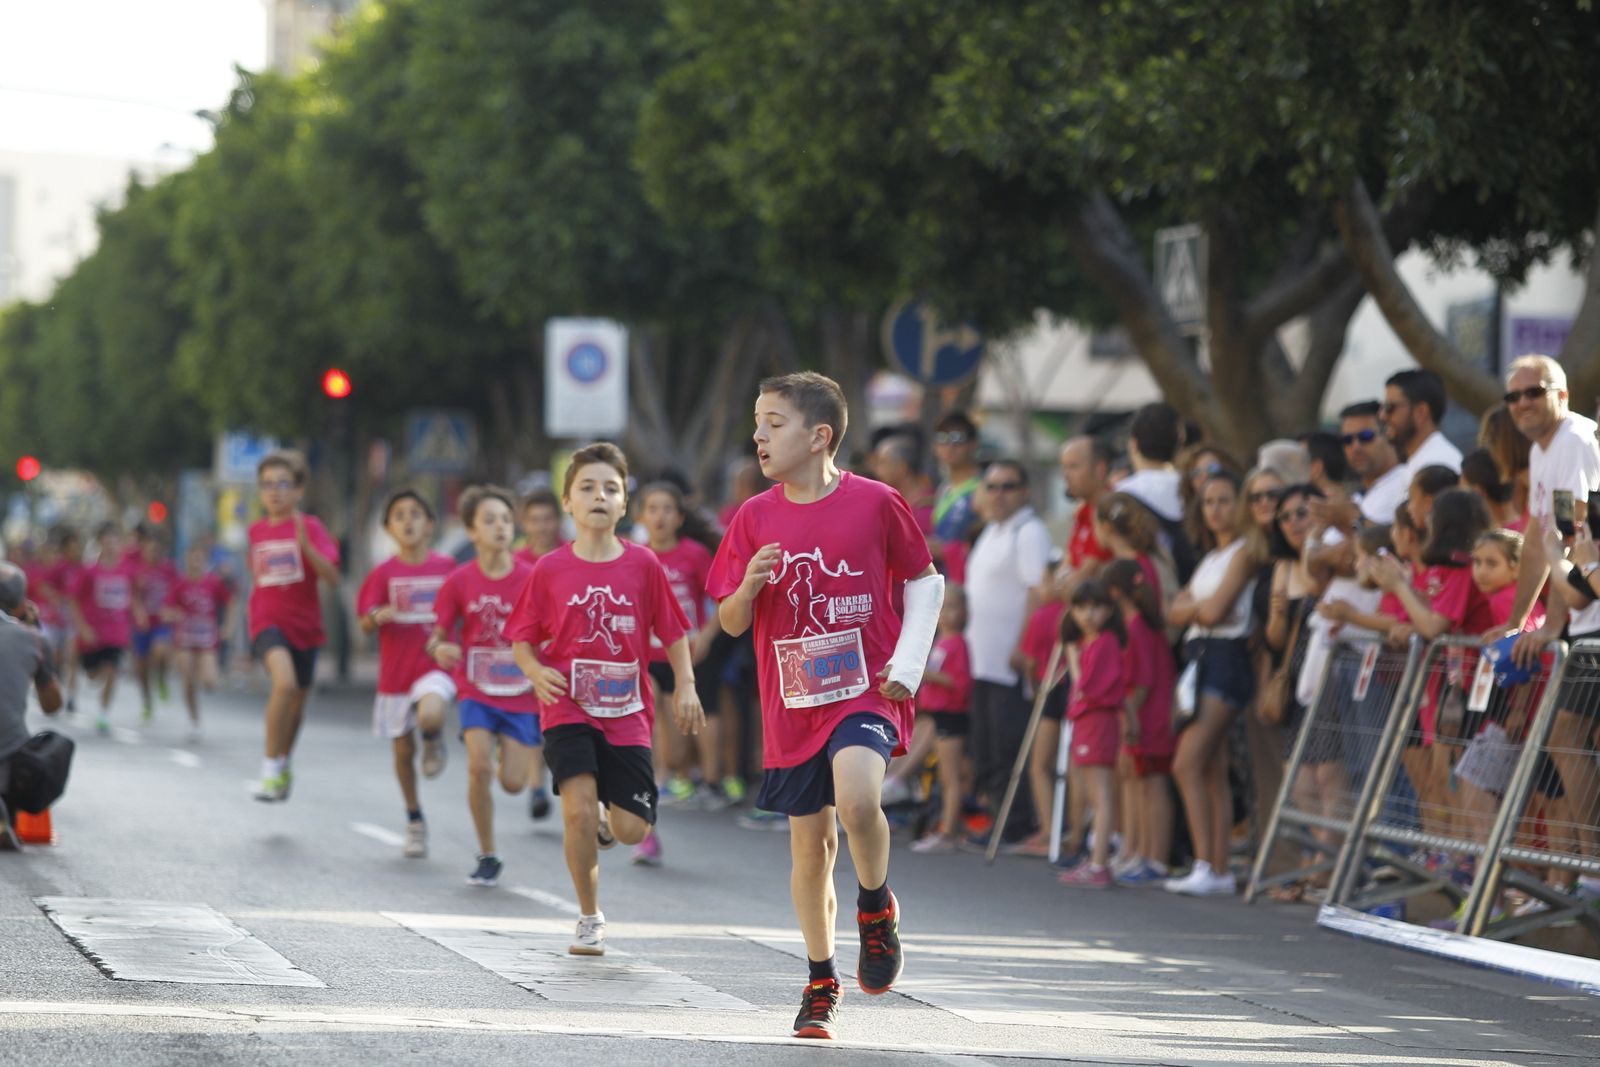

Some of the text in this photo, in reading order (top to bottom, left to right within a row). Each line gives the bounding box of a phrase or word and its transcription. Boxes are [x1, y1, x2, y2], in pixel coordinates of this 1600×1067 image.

[824, 593, 873, 624] 4 CARRERA
[836, 603, 872, 615] SOLIDARIA
[802, 650, 859, 679] 1870
[821, 675, 841, 686] JAVIER
